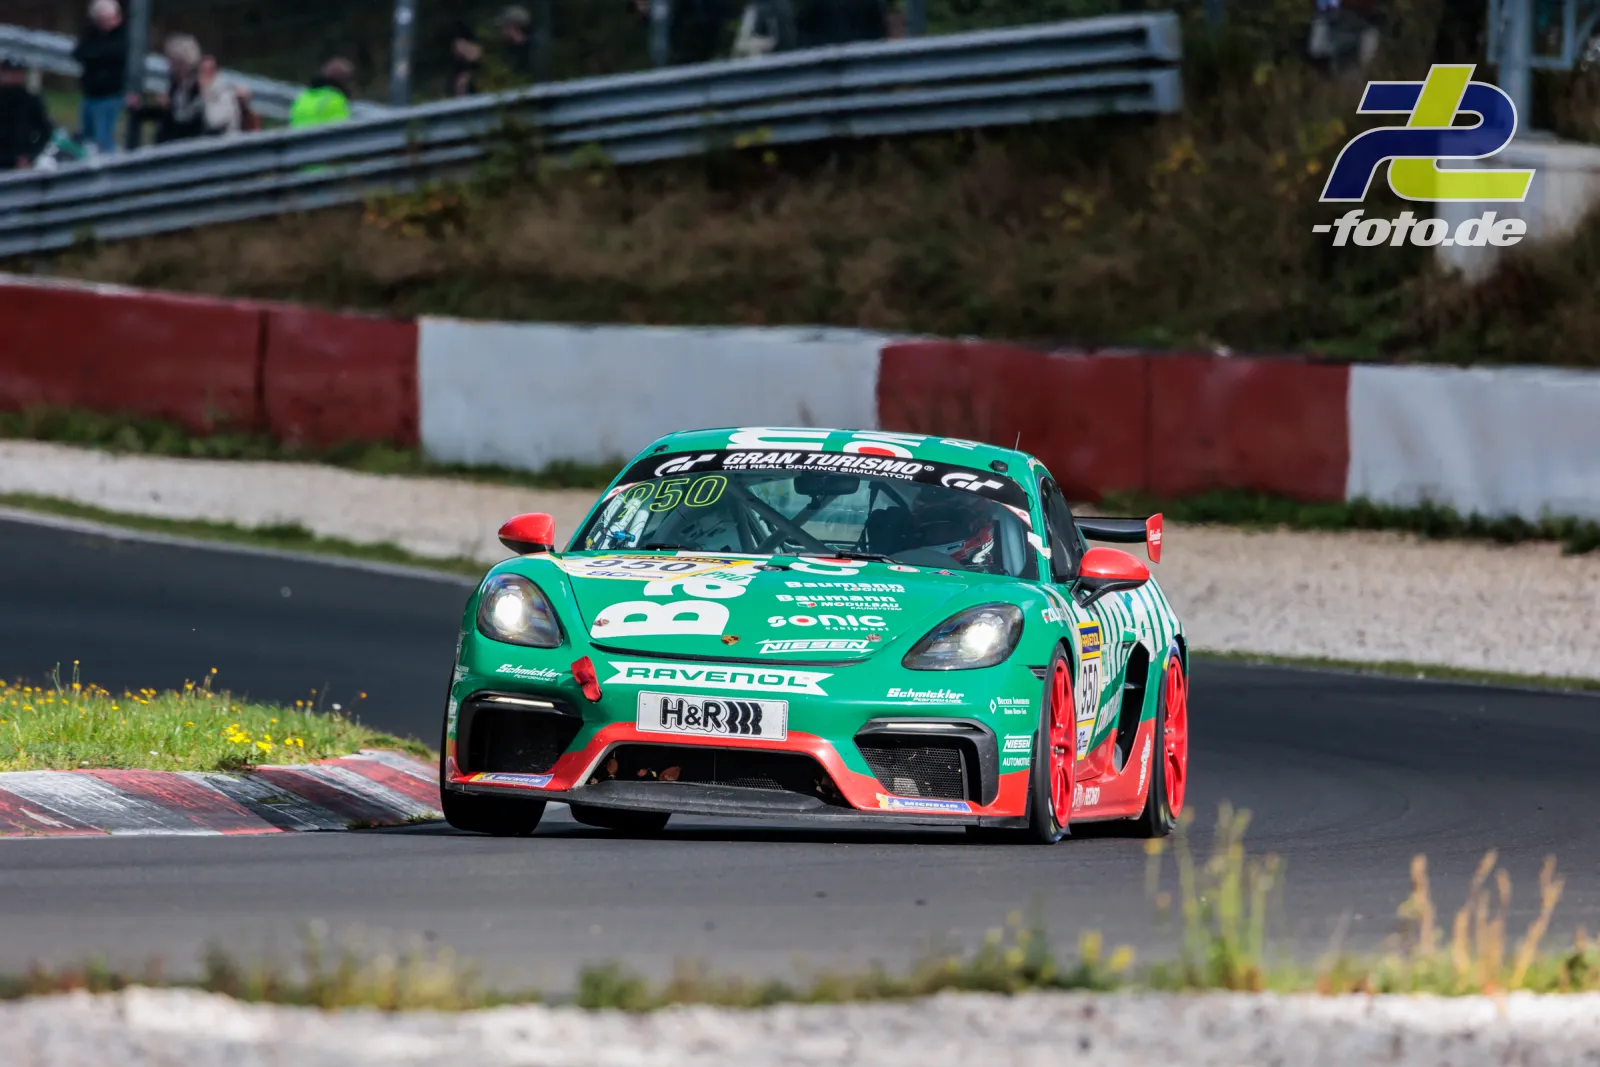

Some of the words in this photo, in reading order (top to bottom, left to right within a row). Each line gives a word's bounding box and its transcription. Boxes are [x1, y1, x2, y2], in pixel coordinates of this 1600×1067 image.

[723, 452, 802, 465] GRAN
[840, 467, 914, 480] SIMULATOR
[618, 475, 728, 519] 950
[585, 559, 698, 572] 950
[784, 581, 905, 590] Baumann
[775, 594, 897, 602] Baumann
[764, 641, 869, 650] NIESEN
[496, 664, 563, 678] Schmickler
[626, 667, 808, 688] RAVENOL
[886, 688, 964, 700] Schmickler
[1080, 663, 1099, 715] 950
[661, 698, 727, 732] H&R
[1005, 739, 1030, 748] NIESEN
[903, 800, 959, 809] MICHELIN
